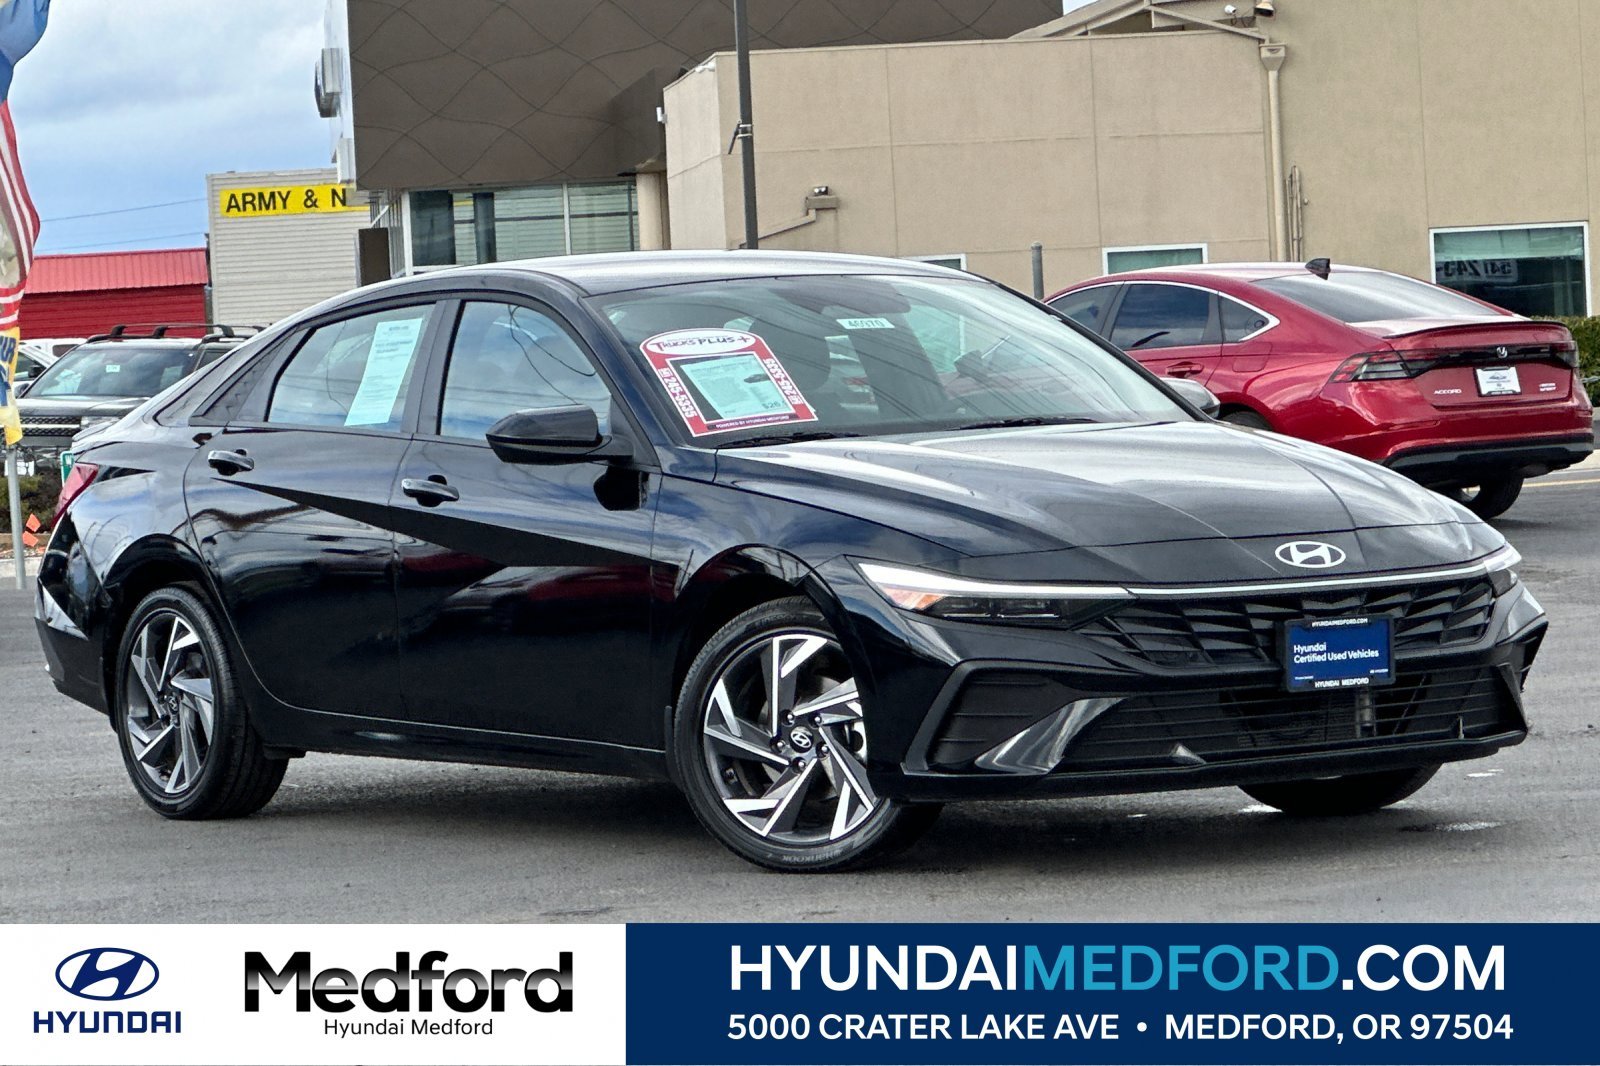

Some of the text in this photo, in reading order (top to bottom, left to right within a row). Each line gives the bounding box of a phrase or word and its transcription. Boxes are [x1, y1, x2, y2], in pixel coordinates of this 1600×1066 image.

[226, 191, 292, 213] ARMY
[303, 189, 319, 209] &
[1293, 642, 1327, 655] Hyundai
[1293, 649, 1379, 664] Certified Used Vehicles
[1314, 677, 1369, 688] HYUNDAI MEDFORD
